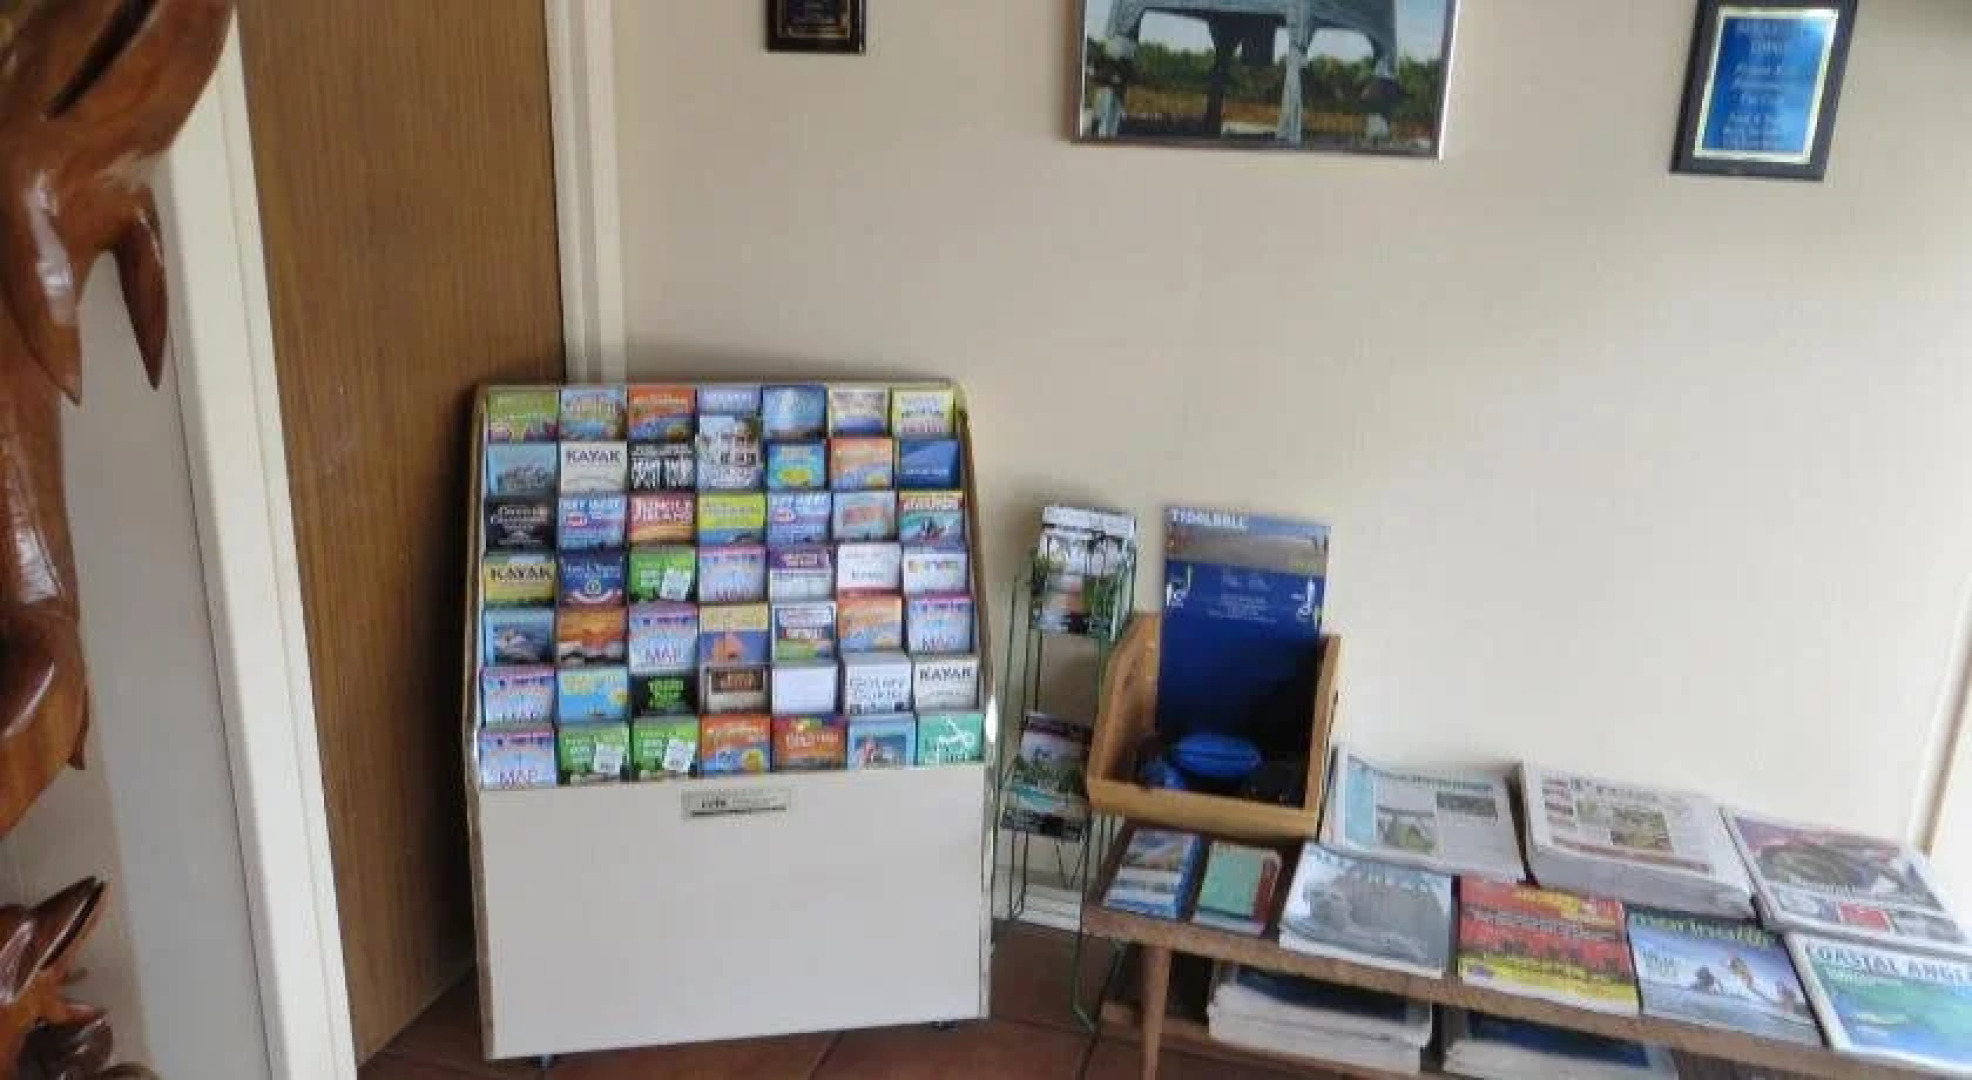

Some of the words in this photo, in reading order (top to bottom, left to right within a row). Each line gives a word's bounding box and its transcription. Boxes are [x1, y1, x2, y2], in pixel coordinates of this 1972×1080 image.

[566, 449, 621, 463] KAYAK
[490, 566, 553, 581] KAYAK
[919, 667, 974, 680] KAYAK
